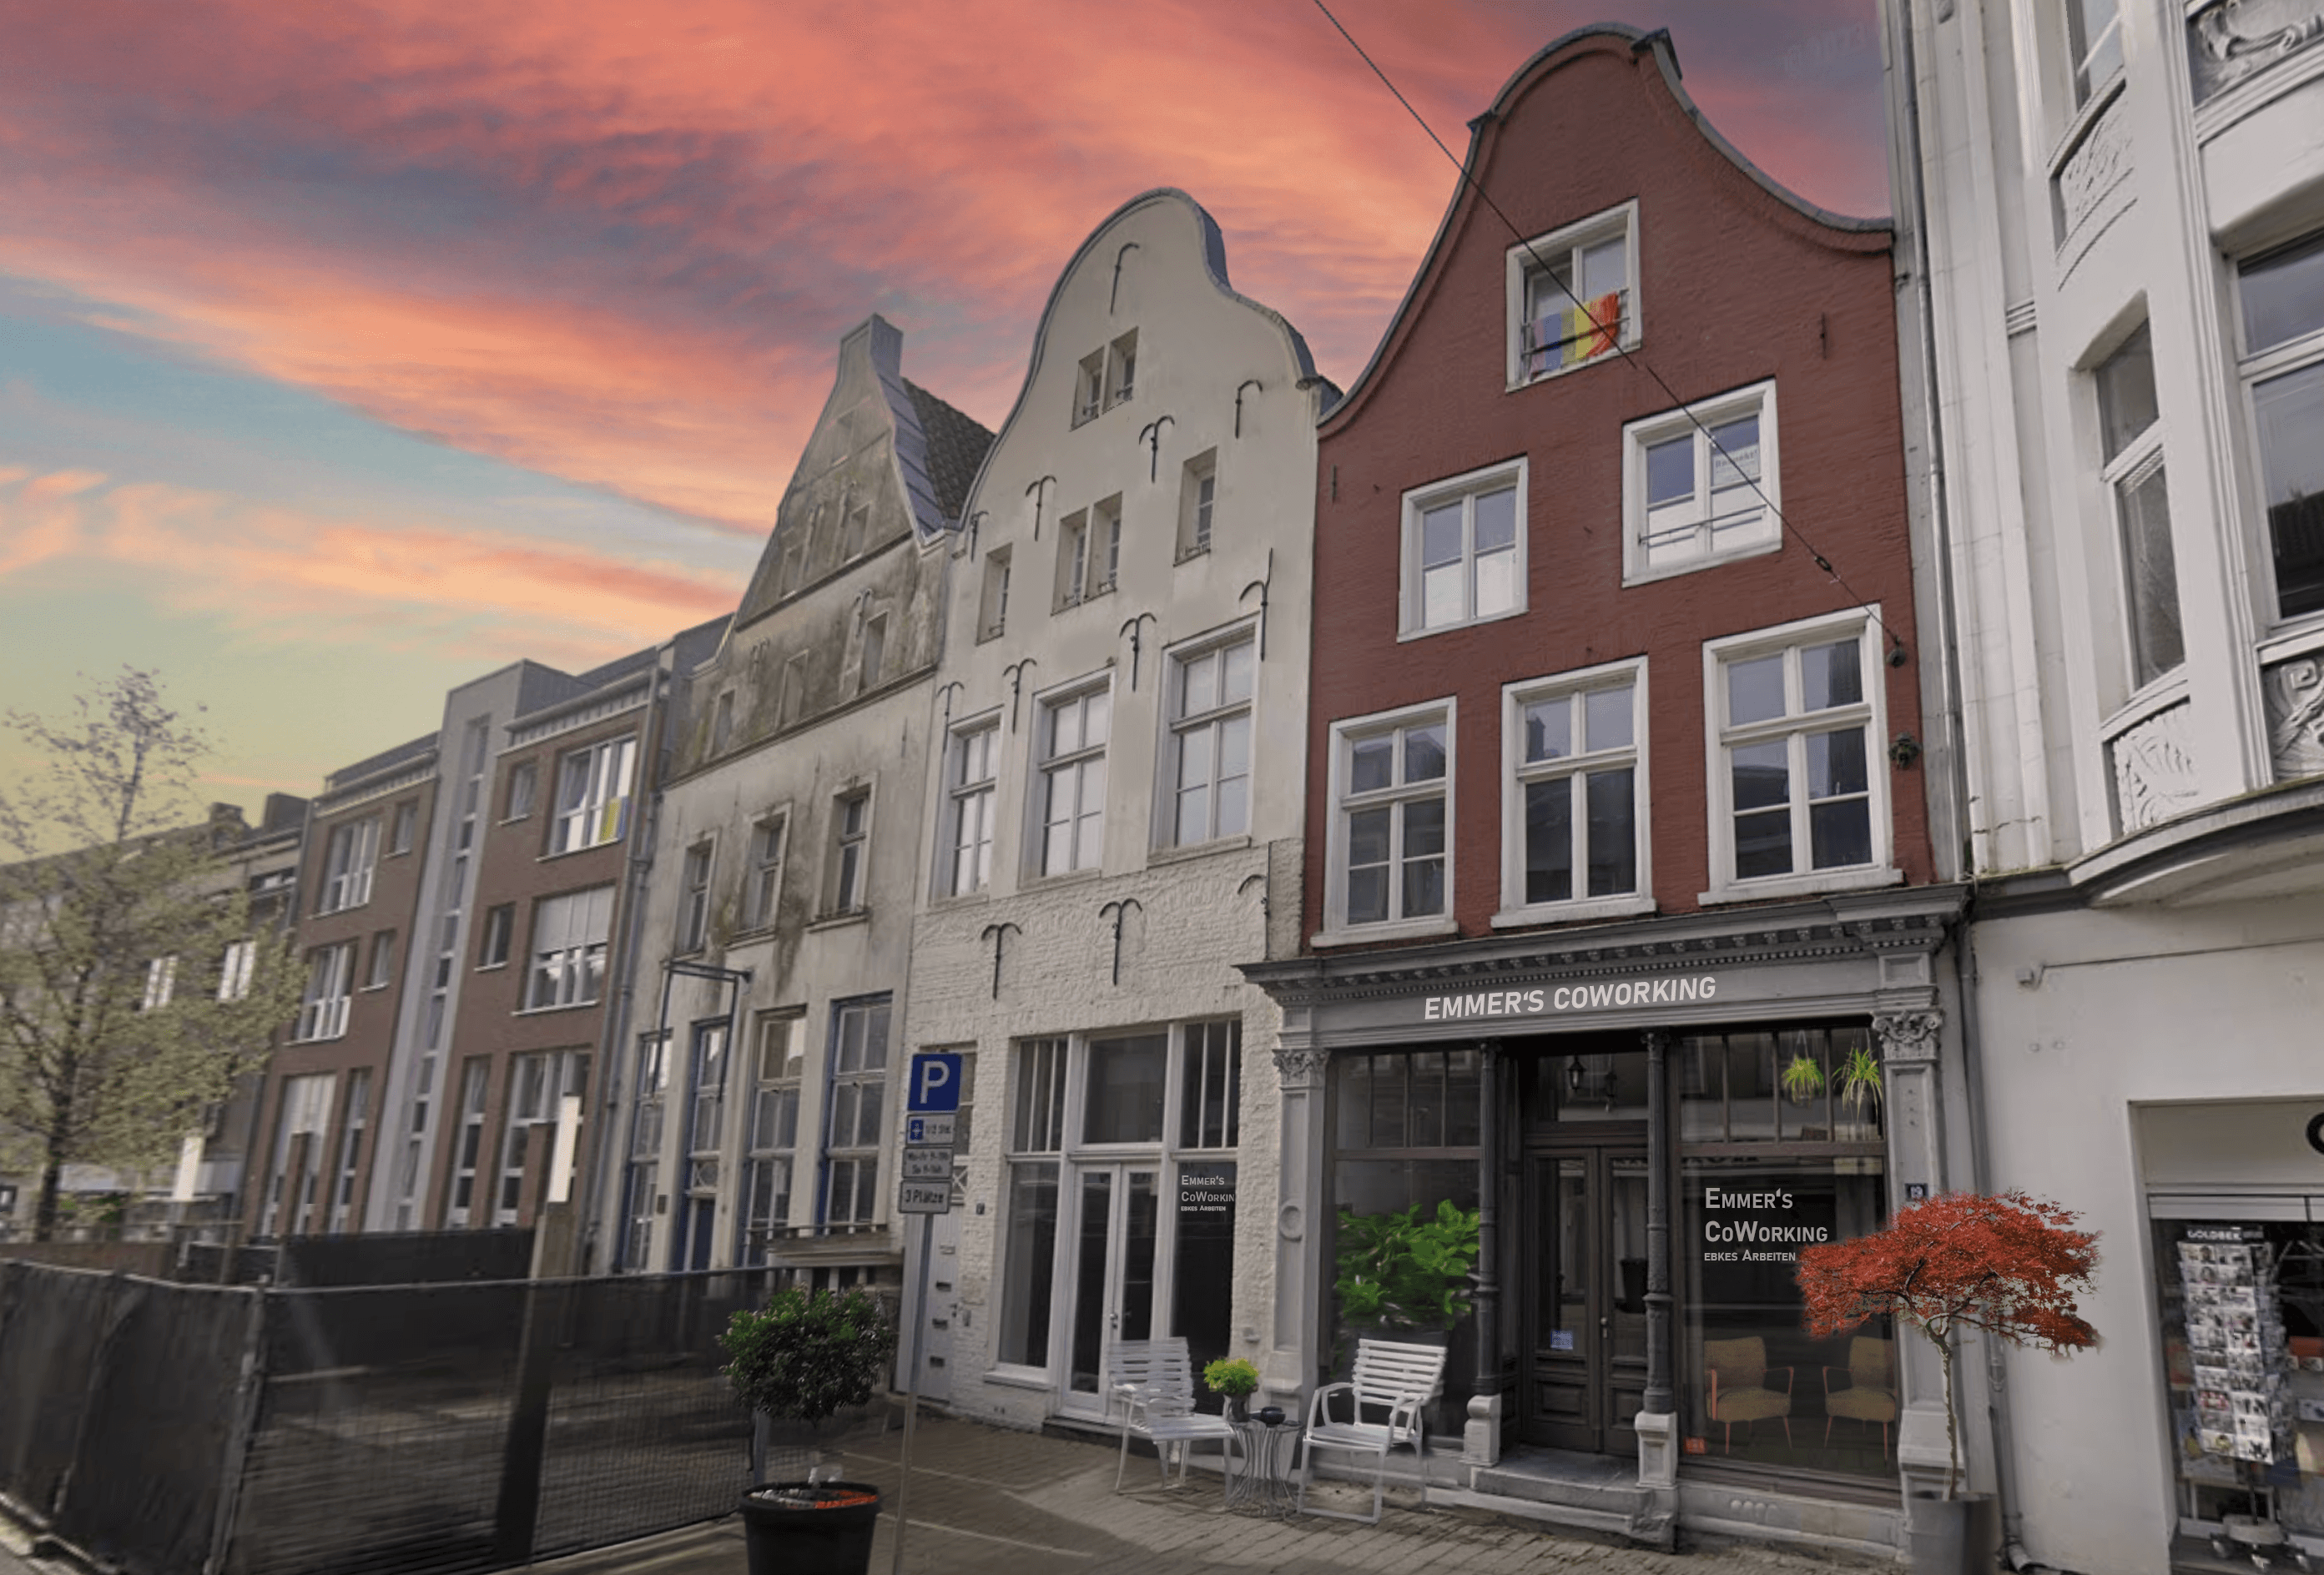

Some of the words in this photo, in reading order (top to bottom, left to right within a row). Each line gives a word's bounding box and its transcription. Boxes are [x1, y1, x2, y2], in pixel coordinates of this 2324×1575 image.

[1424, 989, 1544, 1020] EMMER'S
[1554, 976, 1716, 1009] COWORKING
[920, 1060, 950, 1104] P
